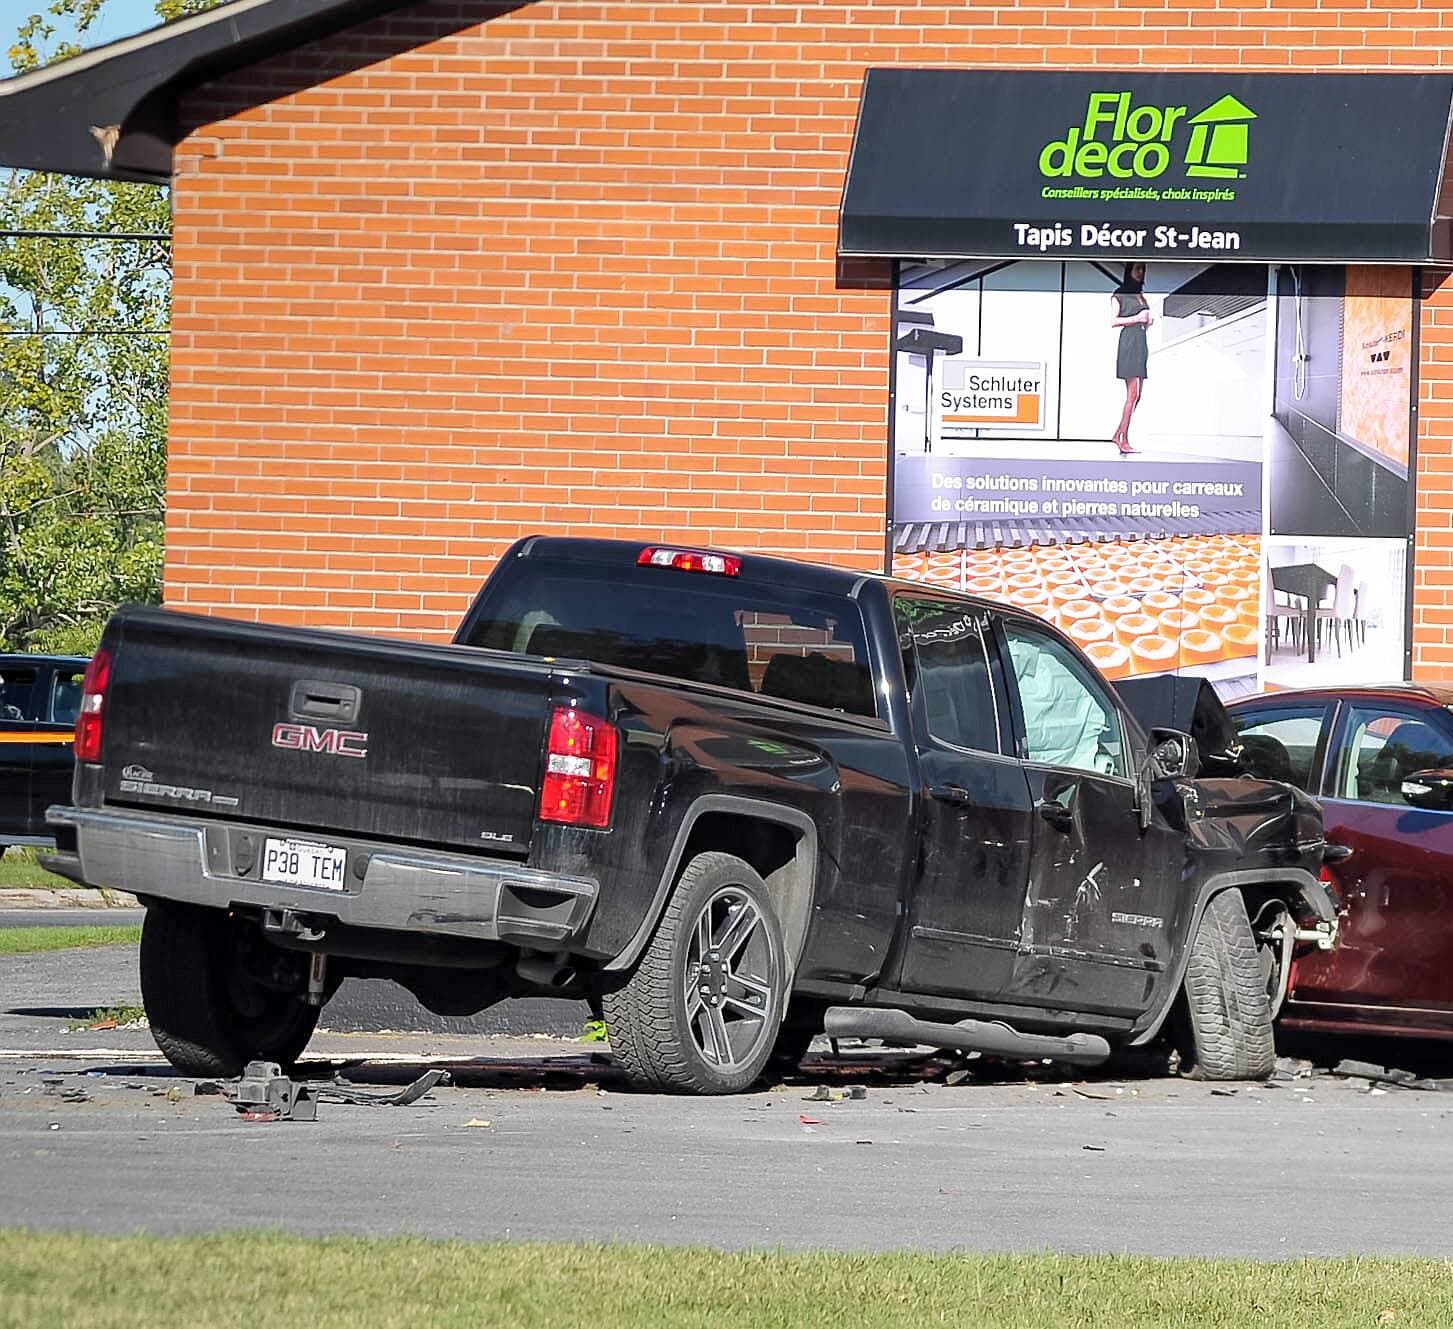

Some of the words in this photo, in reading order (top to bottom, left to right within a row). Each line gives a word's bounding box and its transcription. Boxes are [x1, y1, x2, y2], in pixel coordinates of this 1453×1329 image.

[1083, 92, 1187, 141] Flor
[1039, 128, 1170, 178] deco
[1041, 187, 1099, 199] Conseillers
[1100, 188, 1161, 201] spécialisés,
[1162, 188, 1191, 200] choix
[1192, 188, 1235, 202] inspirés
[1013, 223, 1072, 250] Tapis
[1081, 223, 1147, 247] Décor
[1154, 225, 1241, 249] St-Jean
[969, 375, 1041, 393] Schluter
[941, 391, 1013, 413] Systems
[931, 474, 962, 489] Des
[966, 475, 1038, 490] solutions
[1041, 475, 1128, 494] innovantes
[1131, 481, 1169, 497] pour
[1172, 482, 1244, 497] carreaux
[931, 496, 952, 511] de
[955, 496, 1038, 515] céramique
[1041, 500, 1059, 514] et
[1062, 500, 1118, 517] pierres
[1120, 501, 1200, 518] naturelles
[272, 722, 369, 758] GMC
[120, 780, 212, 802] SIERRA
[267, 849, 299, 875] P38
[312, 855, 343, 881] TEM
[1111, 912, 1164, 928] SIERRA
